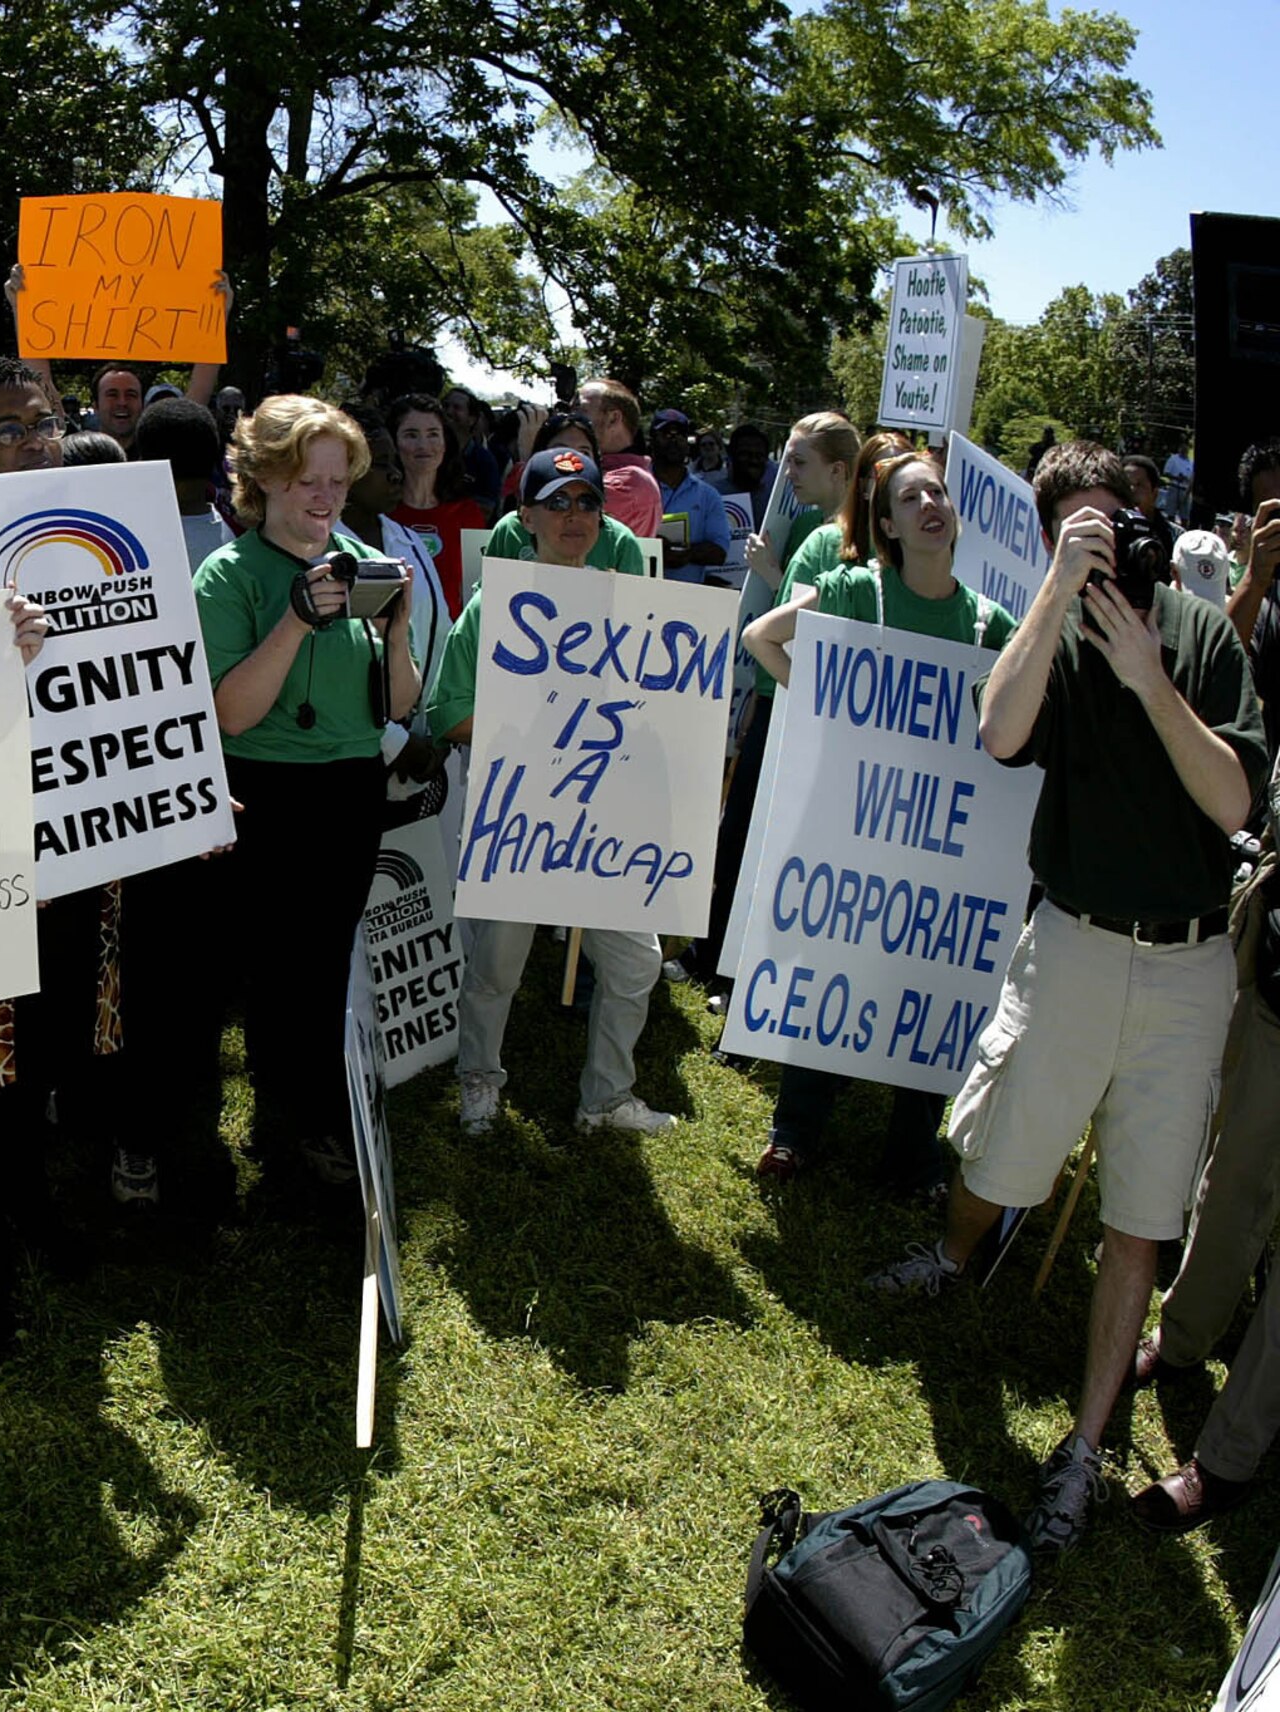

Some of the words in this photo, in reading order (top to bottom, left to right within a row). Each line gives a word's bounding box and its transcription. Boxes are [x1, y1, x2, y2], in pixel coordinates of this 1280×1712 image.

[28, 203, 196, 270] IRON
[93, 273, 144, 304] MY
[907, 270, 945, 298] Hootie
[899, 308, 947, 339] Patootie,
[892, 344, 929, 372] Shame
[933, 354, 947, 373] on
[895, 381, 938, 413] Youtie!
[959, 459, 1039, 567] WOMEN
[815, 640, 965, 745] WOMEN
[31, 711, 208, 794] ESPECT
[35, 777, 218, 861] AIRNESS
[853, 760, 975, 857] WHILE
[390, 910, 434, 936] BUREAU
[396, 886, 428, 906] PUSH
[772, 857, 1008, 974] CORPORATE
[744, 958, 878, 1053] C.E.O.s
[886, 988, 988, 1073] PLAY
